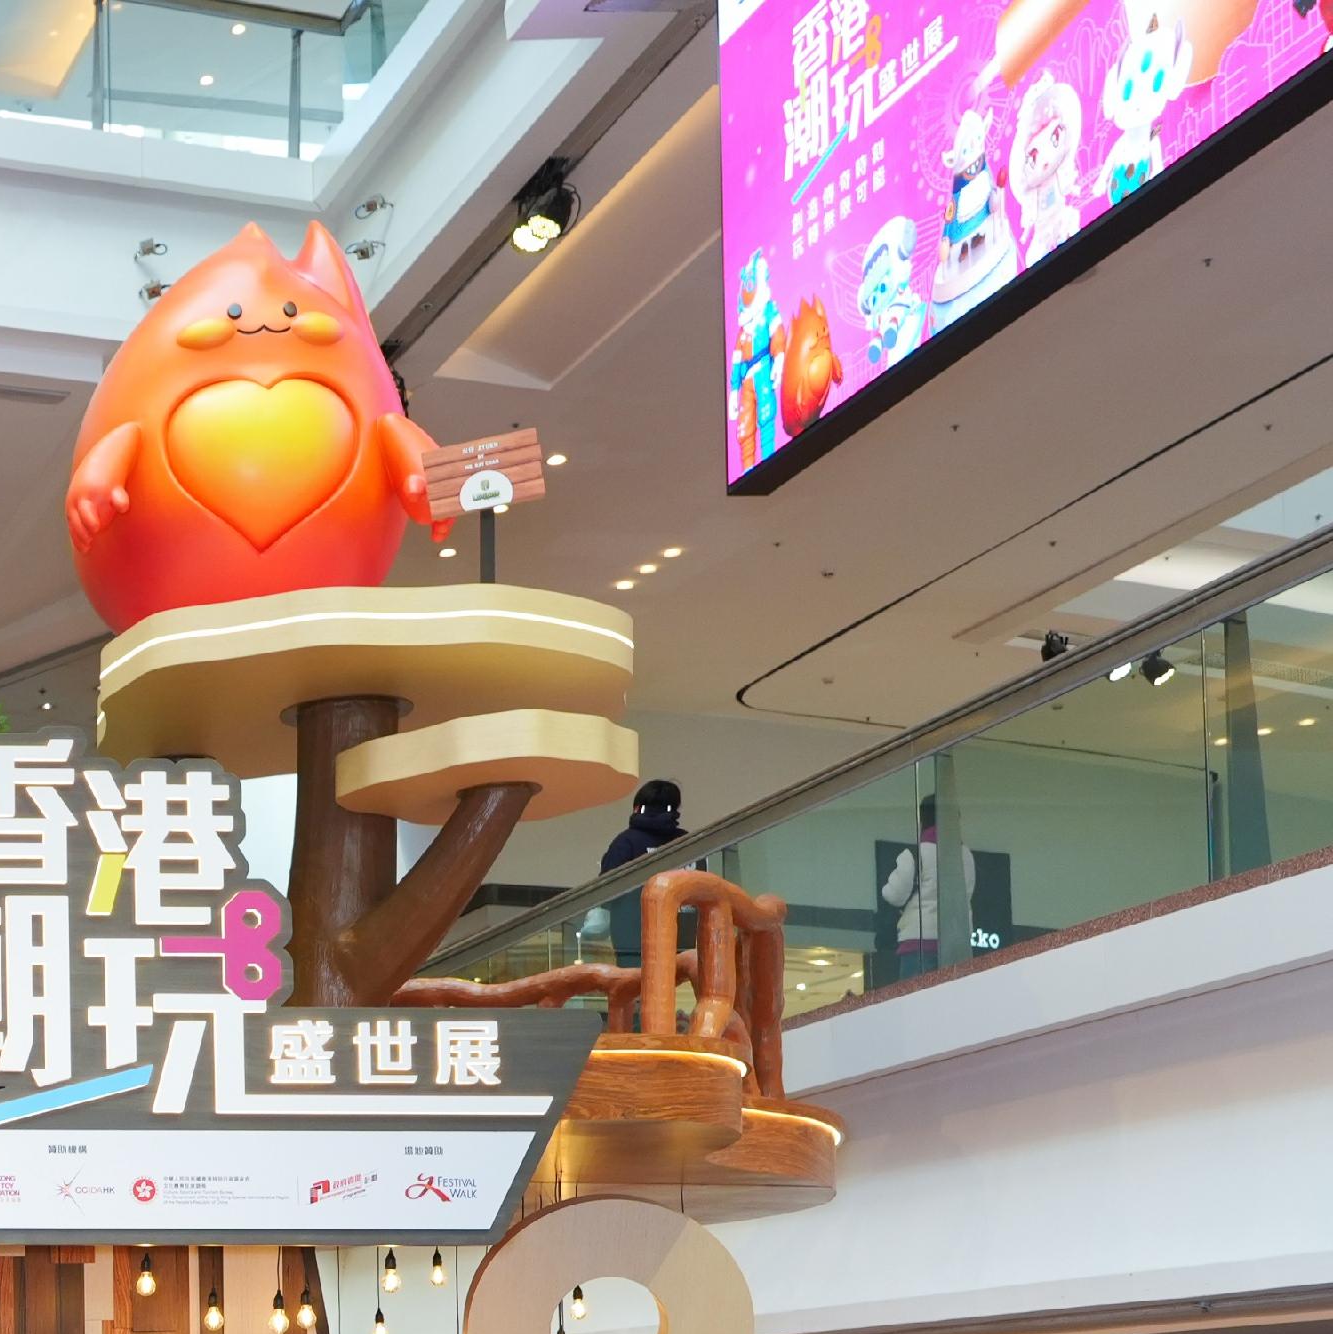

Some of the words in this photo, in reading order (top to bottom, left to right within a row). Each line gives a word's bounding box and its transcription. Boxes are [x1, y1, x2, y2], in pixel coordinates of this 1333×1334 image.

[270, 1019, 503, 1086] 盛世展
[437, 1176, 477, 1188] FESTIVAL
[449, 1188, 477, 1199] WALK
